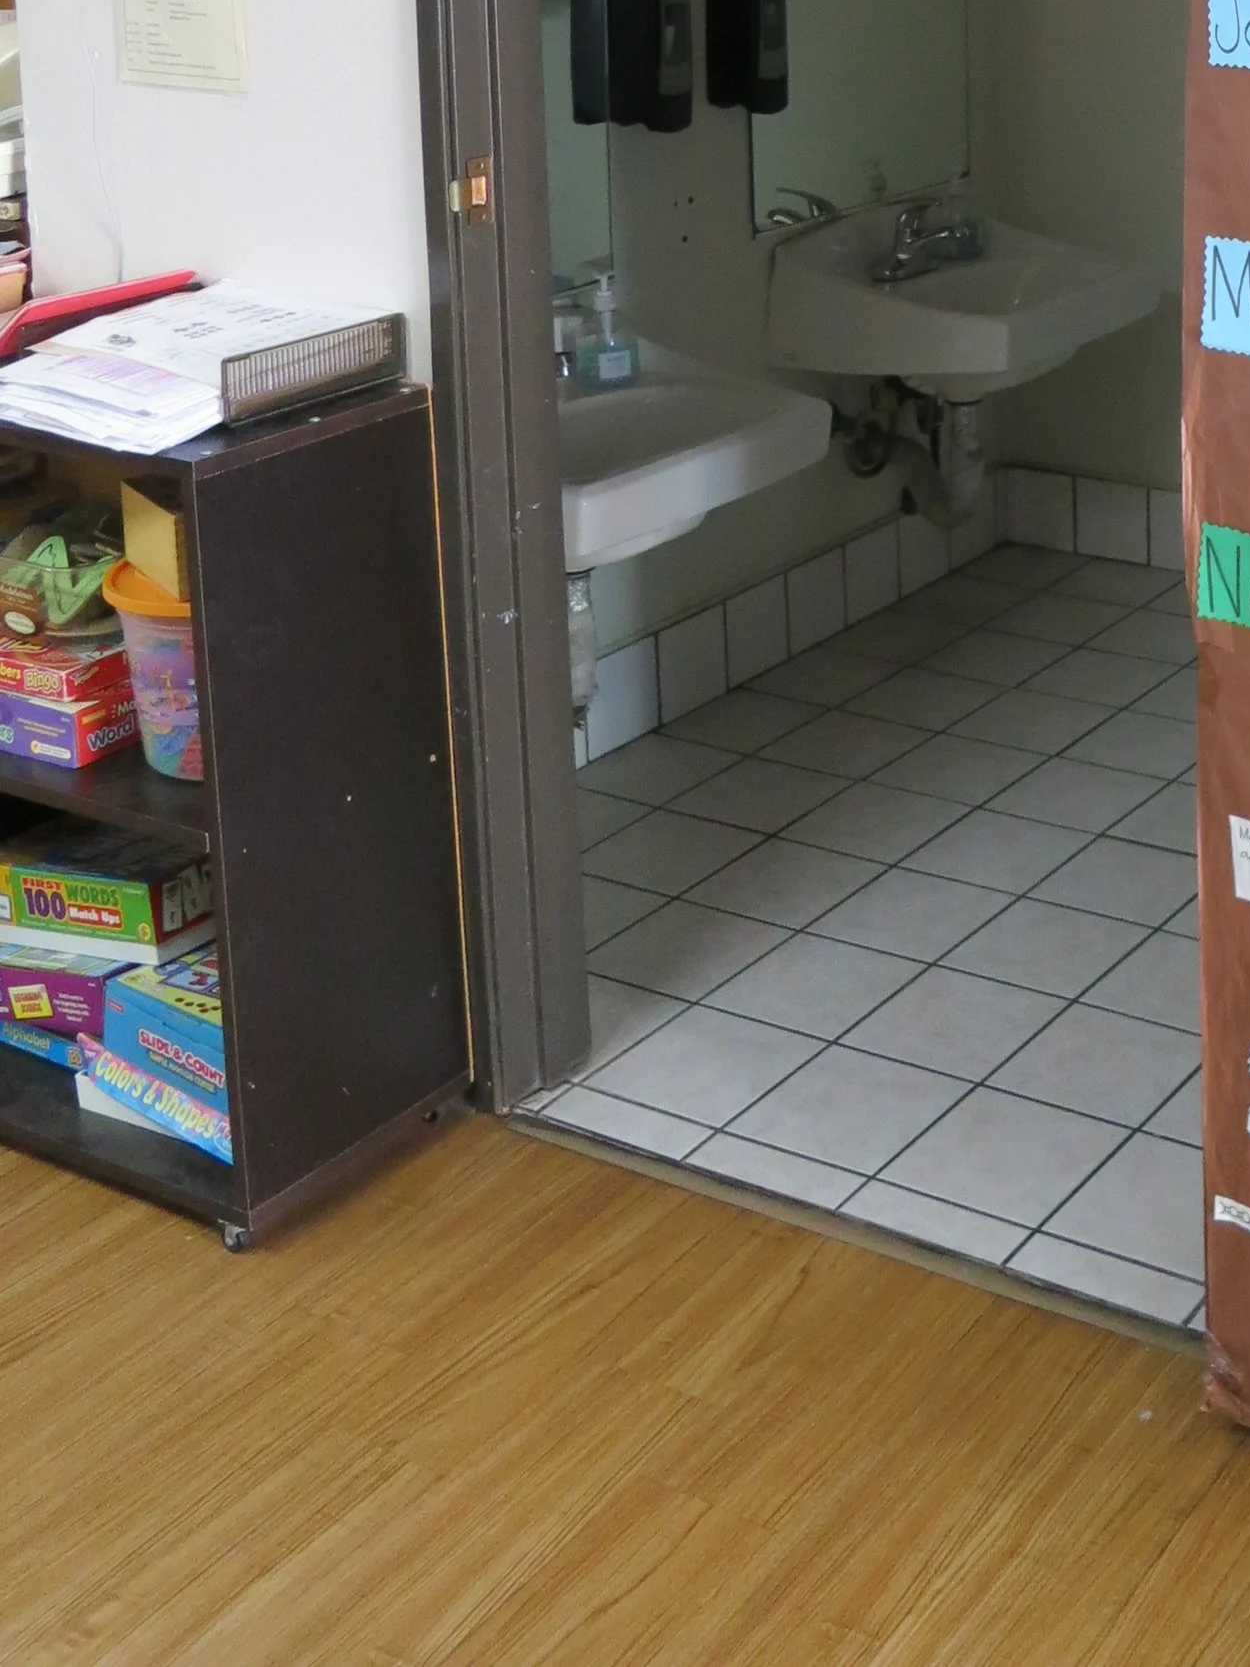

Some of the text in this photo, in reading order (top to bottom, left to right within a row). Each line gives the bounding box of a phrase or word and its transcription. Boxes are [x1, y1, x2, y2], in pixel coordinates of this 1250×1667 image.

[25, 671, 61, 692] Bingo
[22, 877, 63, 891] FIRST
[24, 883, 120, 921] 100 WORDS
[69, 905, 99, 924] Match
[139, 1029, 173, 1059] SLIDE
[173, 1047, 183, 1062] &
[185, 1052, 225, 1087] COUNT
[95, 1049, 145, 1098] Colors
[142, 1080, 158, 1105] &
[155, 1084, 215, 1139] Shapes
